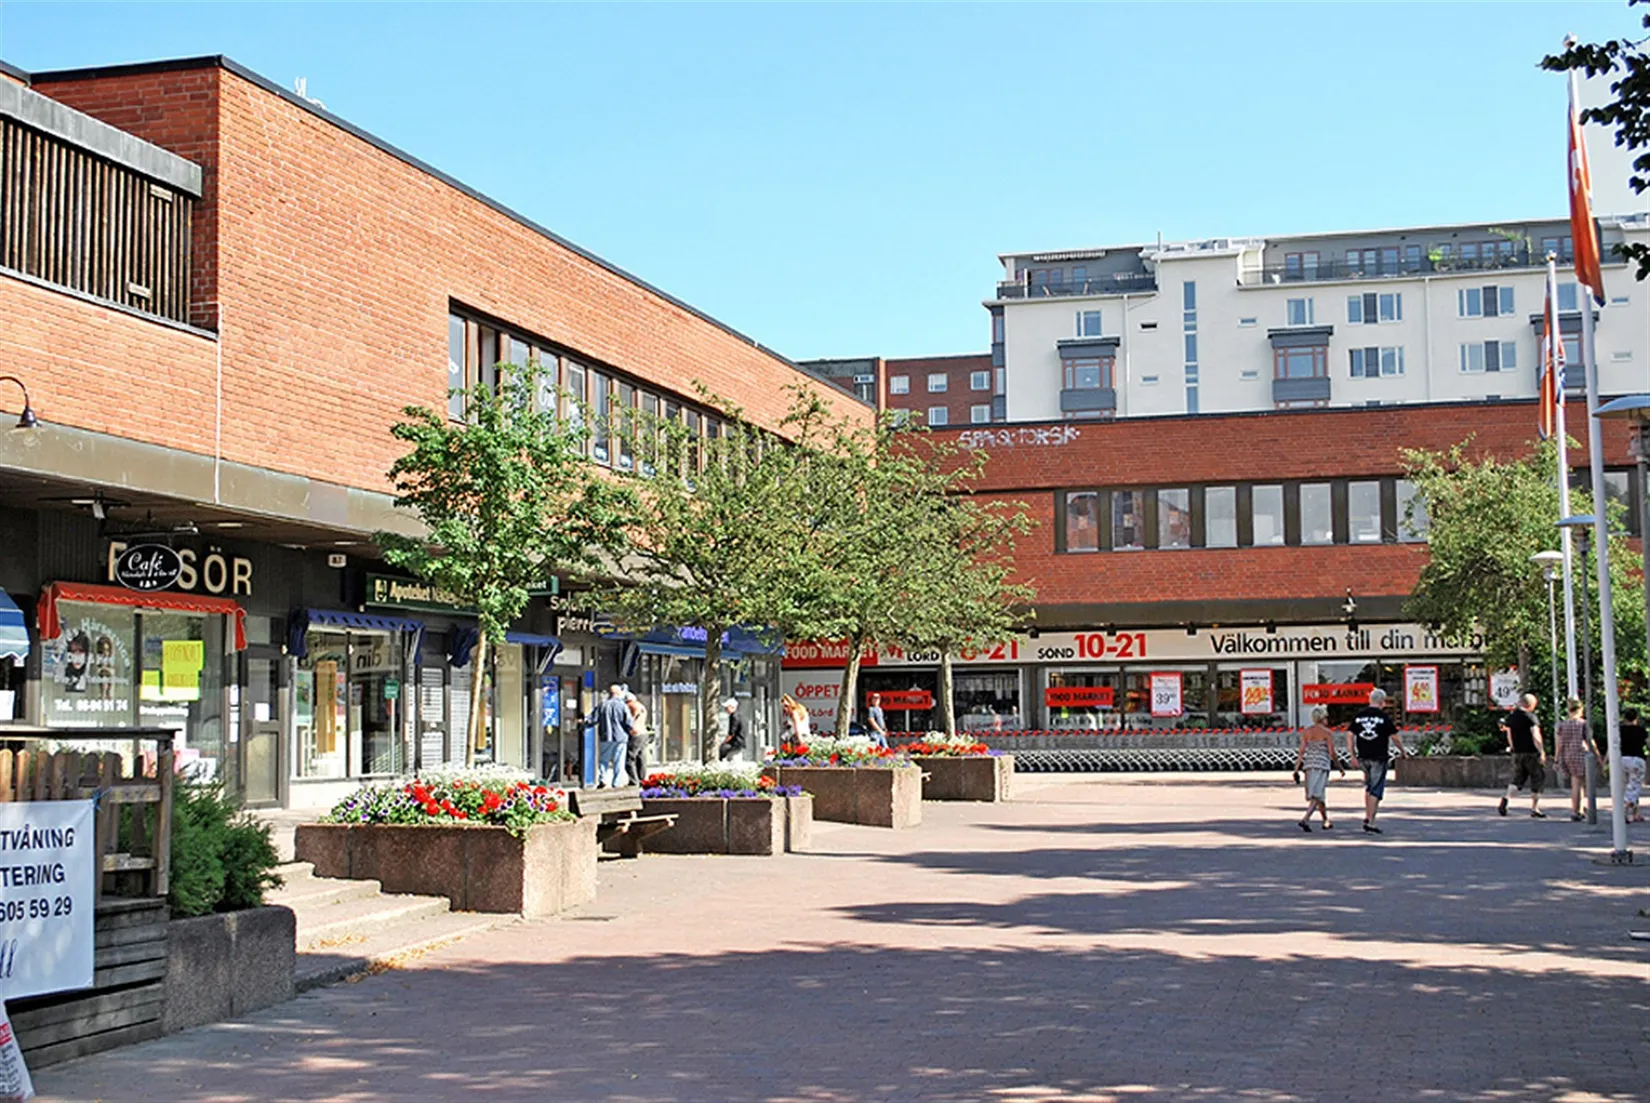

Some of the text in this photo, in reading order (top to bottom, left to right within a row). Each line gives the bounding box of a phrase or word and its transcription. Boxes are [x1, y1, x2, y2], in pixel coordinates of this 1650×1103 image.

[108, 541, 252, 596] FSÖR
[128, 551, 163, 577] Café
[784, 645, 818, 660] FOOD
[1073, 632, 1147, 659] 10-21
[1210, 632, 1337, 654] Välkommen
[1345, 630, 1371, 651] till
[1380, 628, 1414, 650] din
[29, 898, 50, 919] 59
[54, 896, 72, 916] 29
